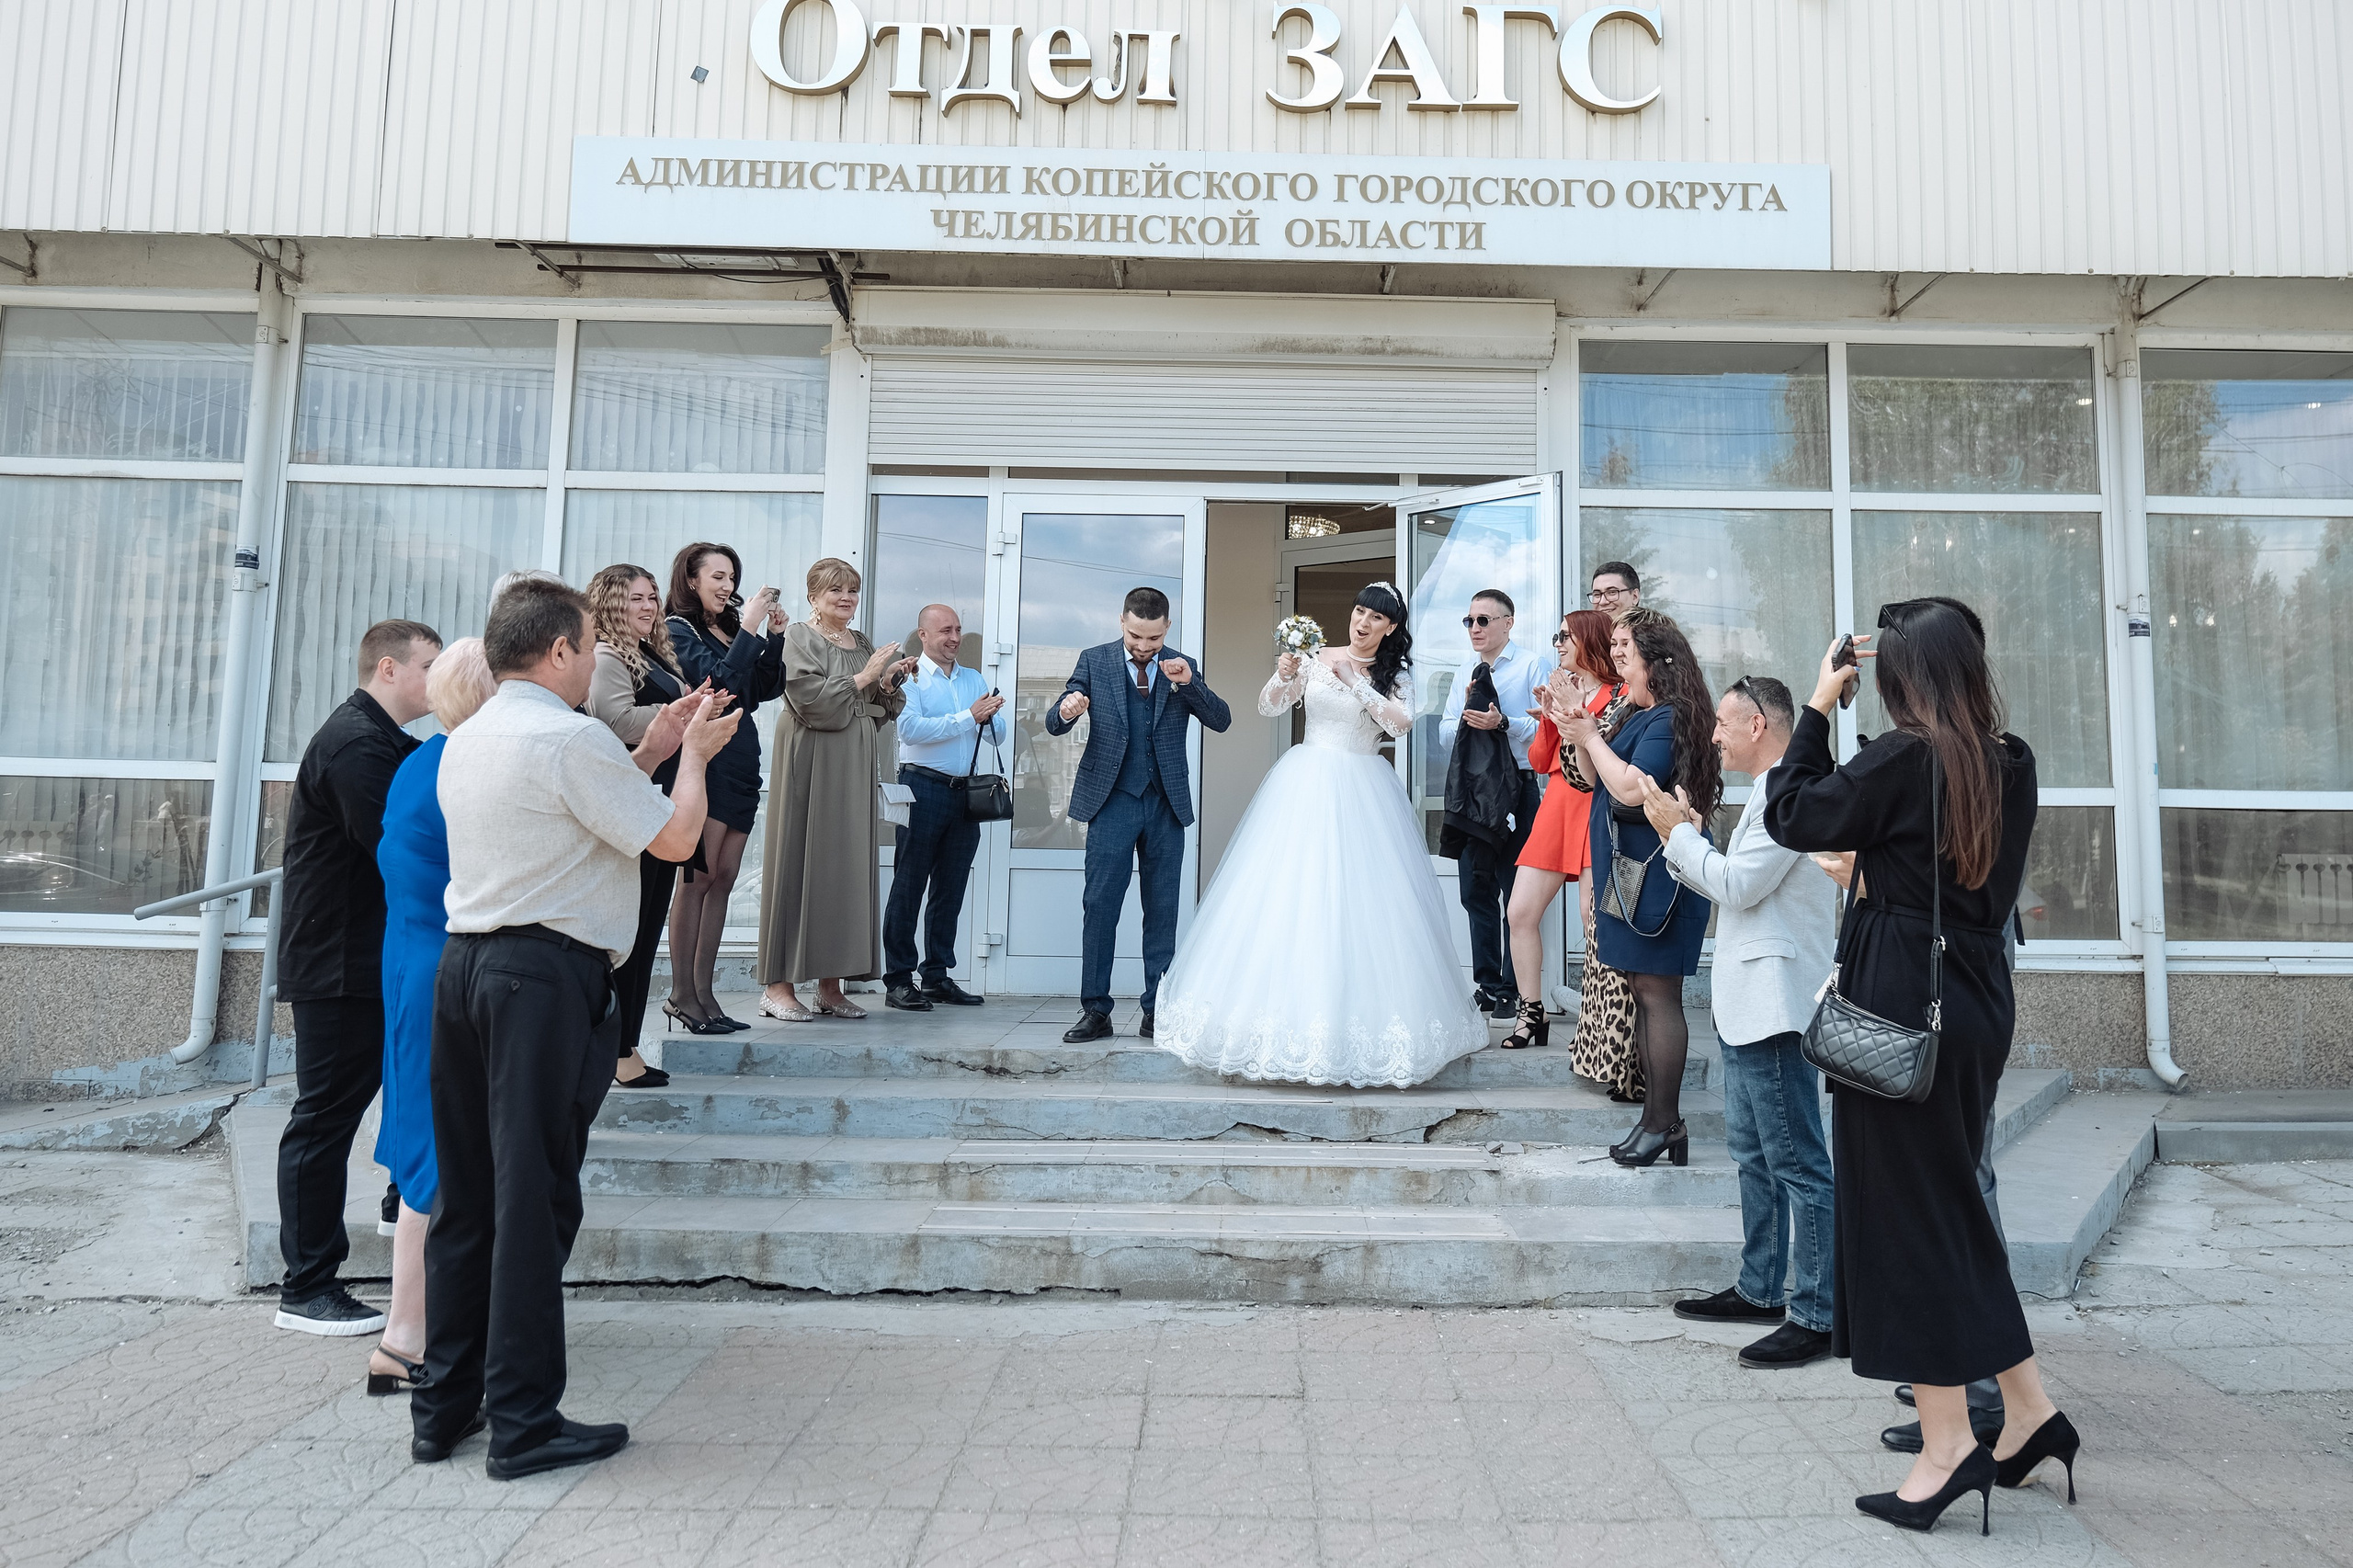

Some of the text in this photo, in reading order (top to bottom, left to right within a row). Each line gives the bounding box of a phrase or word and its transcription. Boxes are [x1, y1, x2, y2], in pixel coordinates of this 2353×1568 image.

[750, 0, 1663, 119] Отдел ЗАГС
[616, 156, 1788, 211] АДМИНИСТРАЦИИ КОПЕЙСКОГО ГОРОДСКОГО ОКРУГА
[930, 209, 1487, 251] ЧЕЛЯБИНСКОЙ ОБЛАСТИ
